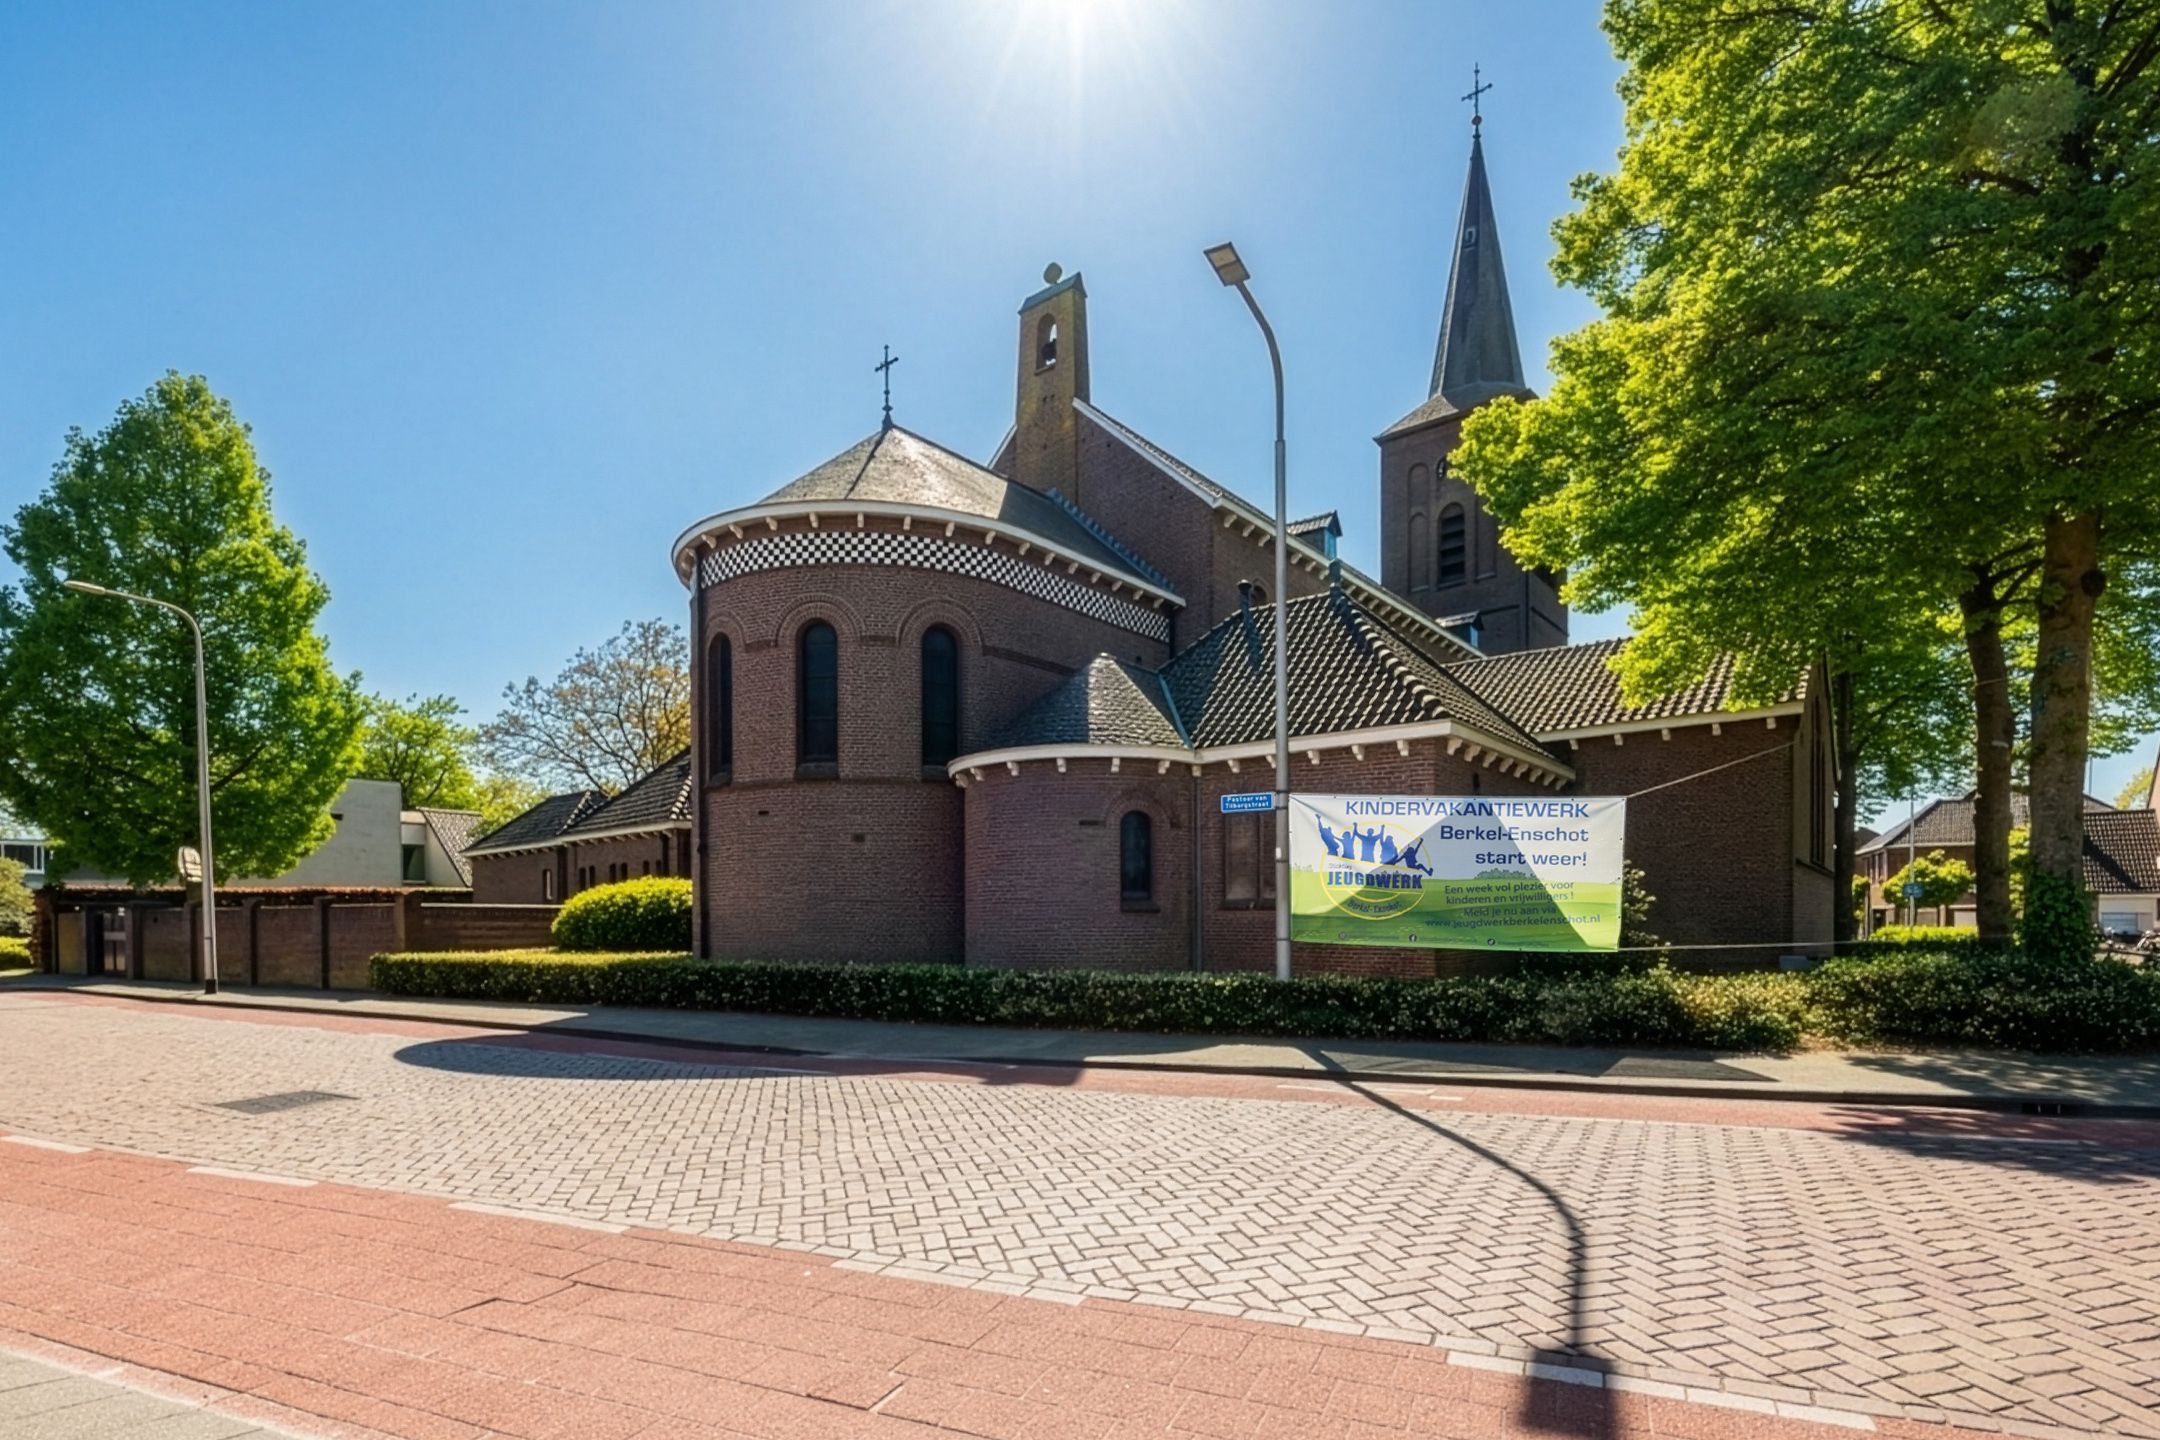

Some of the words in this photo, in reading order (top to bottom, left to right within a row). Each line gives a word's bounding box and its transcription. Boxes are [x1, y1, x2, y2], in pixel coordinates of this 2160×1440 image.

[1345, 801, 1589, 818] KINDERVAKANTIEWERK
[1440, 825, 1589, 842] Berkel-Enschot
[1475, 851, 1527, 865] start
[1532, 851, 1588, 867] weer!
[1327, 871, 1423, 890] JEUGDWERK
[1445, 885, 1463, 895] Een
[1466, 883, 1493, 894] week
[1495, 882, 1511, 892] vol
[1513, 881, 1549, 894] plezier
[1551, 882, 1575, 890] voor
[1446, 895, 1491, 905] kinderen
[1494, 894, 1507, 902] en
[1509, 892, 1568, 904] vrijwilligers
[1464, 908, 1490, 917] Meld
[1492, 907, 1501, 918] je
[1504, 907, 1518, 916] nu
[1519, 907, 1540, 915] aan
[1542, 904, 1557, 914] via
[1425, 915, 1601, 929] www.jeugdwerkberkelenschot.nl
